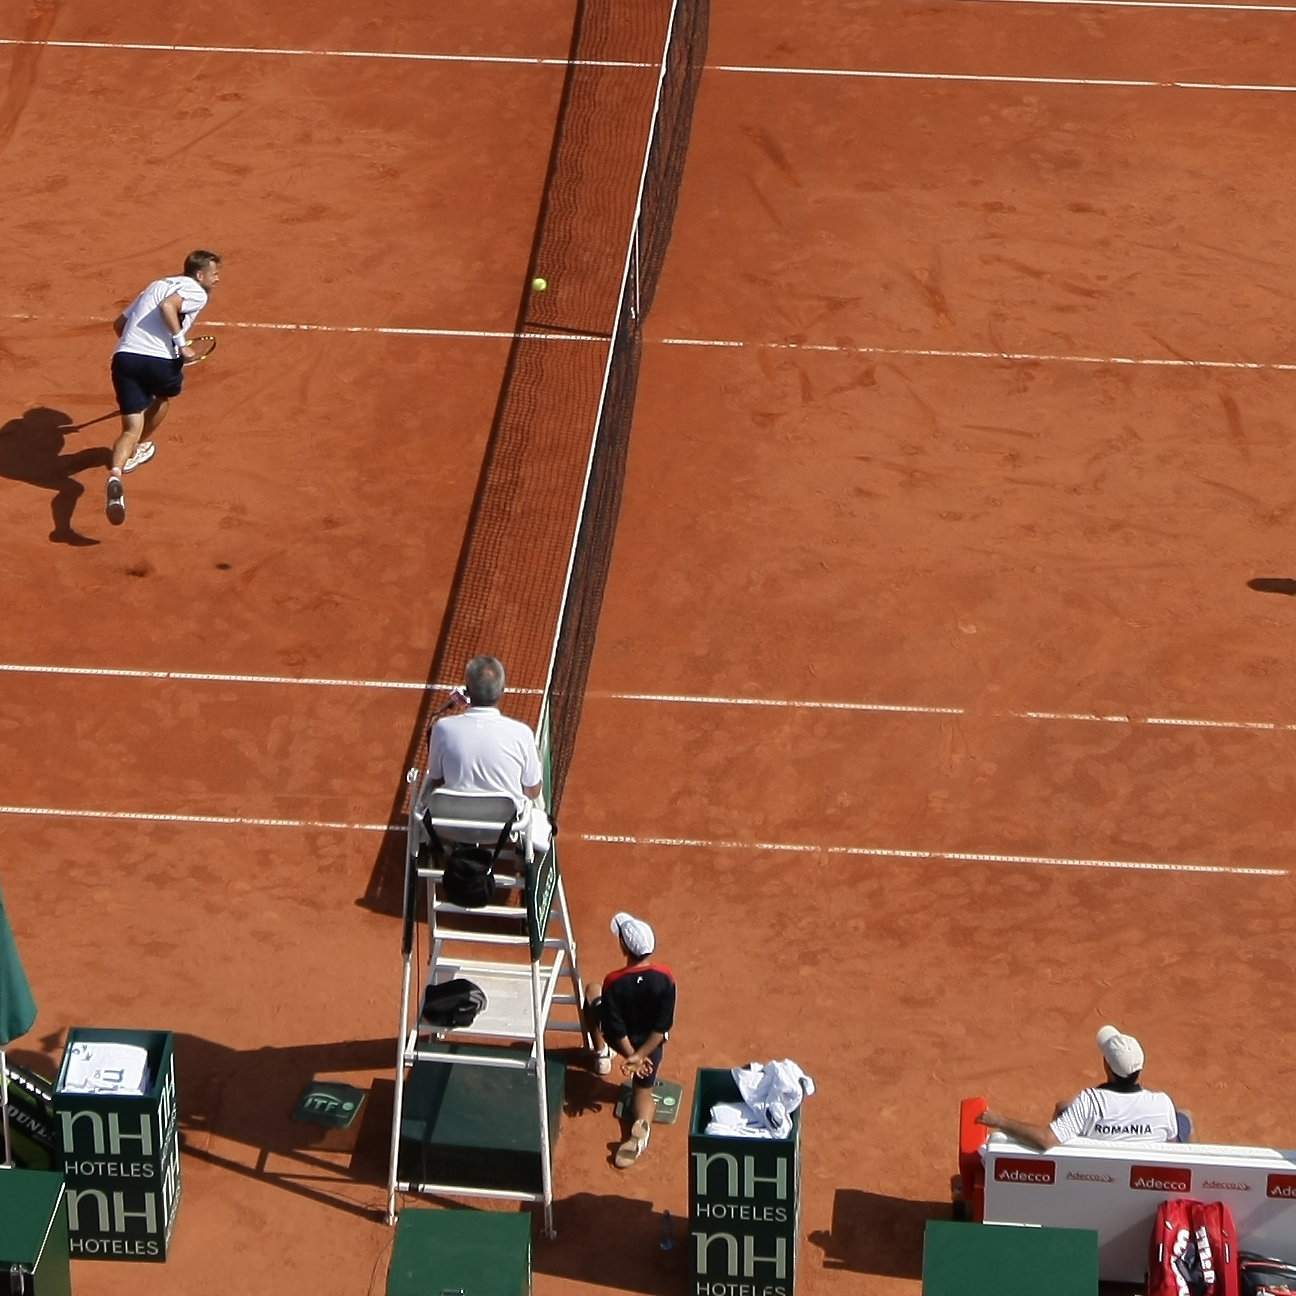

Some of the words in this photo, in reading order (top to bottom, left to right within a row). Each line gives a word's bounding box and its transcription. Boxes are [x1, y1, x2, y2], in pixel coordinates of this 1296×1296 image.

[304, 1097, 339, 1112] ITF
[5, 1104, 56, 1142] DUNL
[1095, 1123, 1152, 1135] ROMANIA
[65, 1160, 154, 1178] HOTELES
[999, 1169, 1051, 1183] Adecco
[1135, 1177, 1187, 1190] Adecco
[696, 1203, 787, 1222] HOTELES
[70, 1238, 159, 1256] HOTELES
